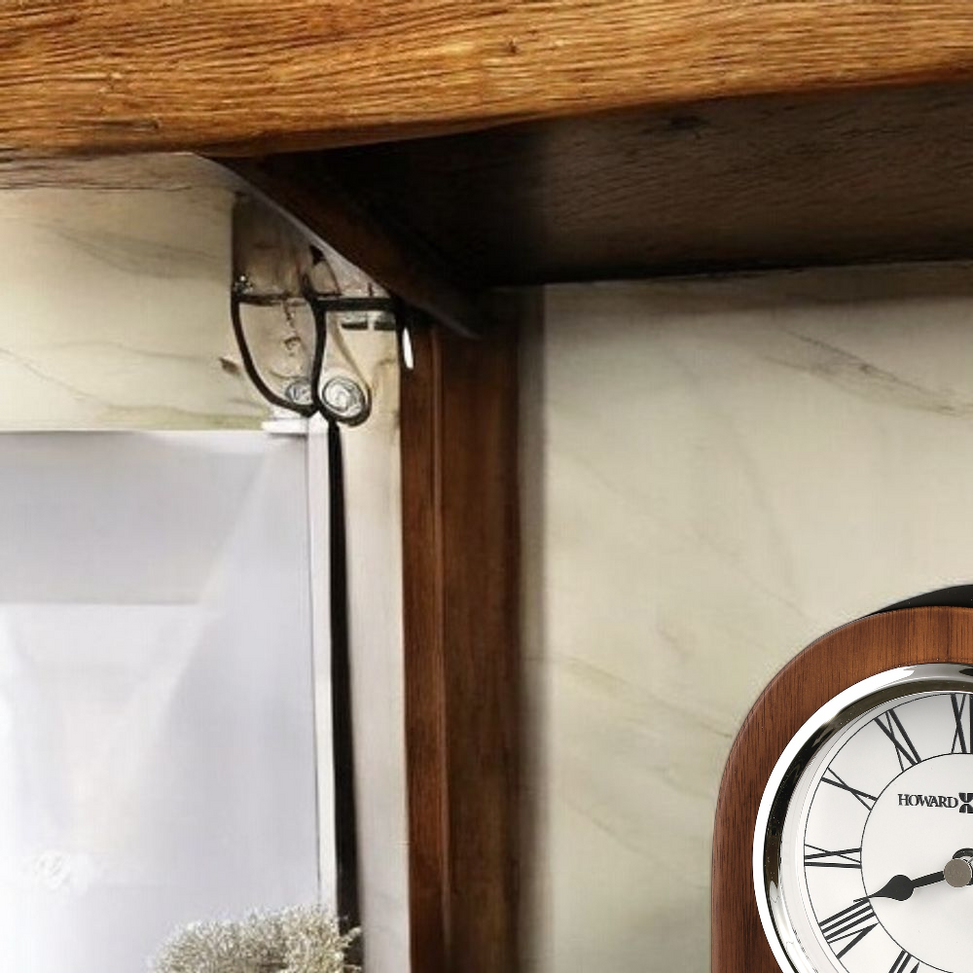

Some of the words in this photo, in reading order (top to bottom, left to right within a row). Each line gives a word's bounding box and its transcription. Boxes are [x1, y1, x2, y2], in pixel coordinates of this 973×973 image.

[873, 708, 921, 773] XI
[820, 767, 878, 811] X
[897, 793, 959, 809] HOWARD
[804, 844, 862, 869] IX
[819, 899, 878, 960] VIII
